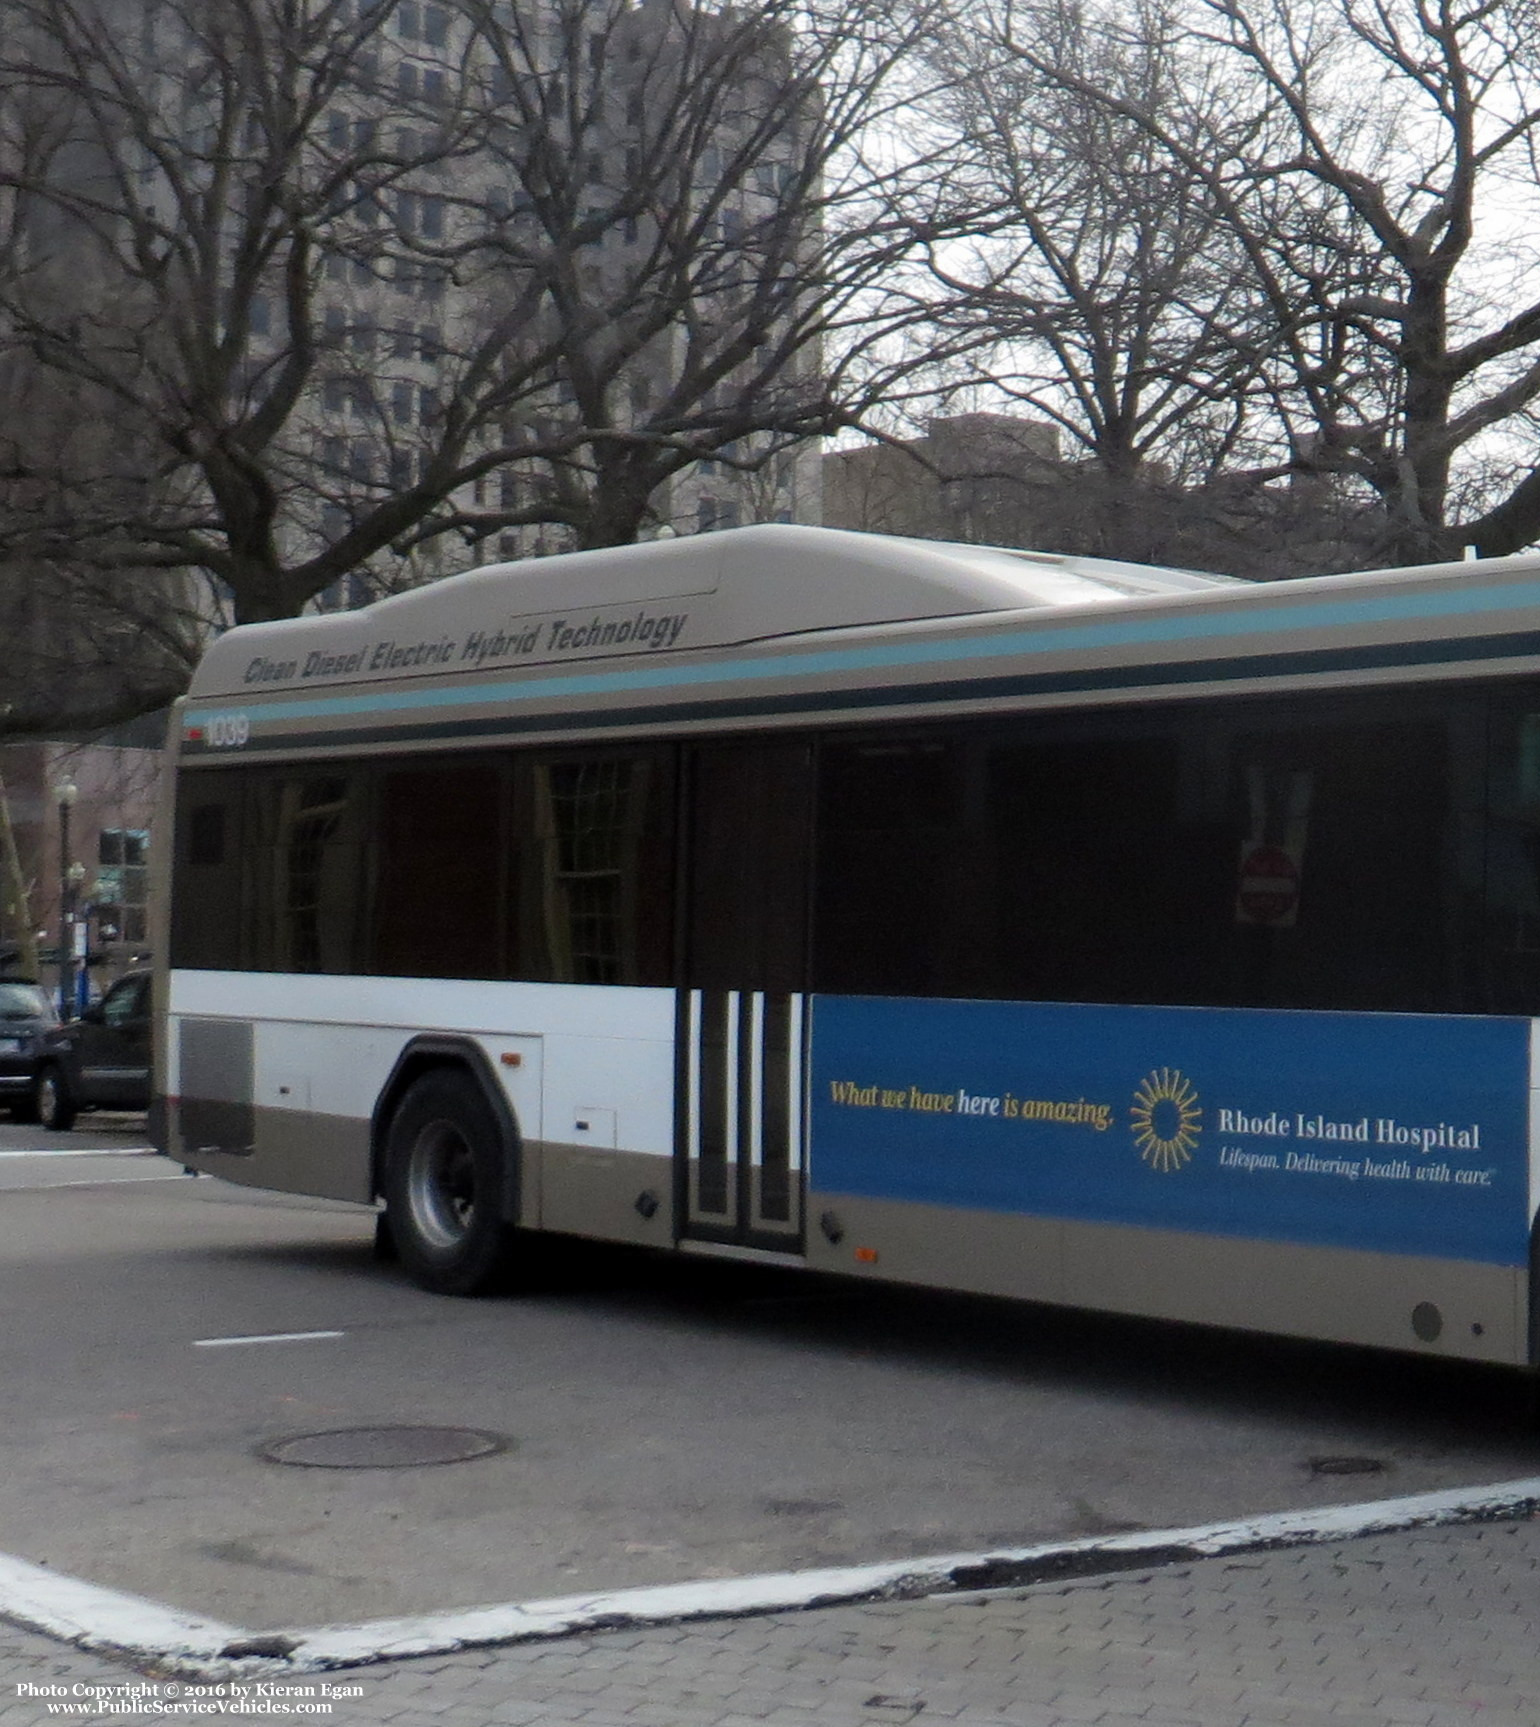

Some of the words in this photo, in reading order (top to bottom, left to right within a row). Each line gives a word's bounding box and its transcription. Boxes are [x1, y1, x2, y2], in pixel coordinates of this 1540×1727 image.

[243, 655, 298, 684] Clean
[301, 644, 370, 678] Diesel
[369, 634, 457, 671] Electric
[460, 622, 543, 667] Hybrid
[547, 611, 689, 649] Technology
[207, 713, 249, 747] 1039
[830, 1079, 878, 1106] What
[881, 1090, 906, 1109] we
[909, 1086, 955, 1113] have
[956, 1088, 1000, 1117] here
[1003, 1091, 1019, 1118] is
[1021, 1096, 1115, 1132] amazing.
[1218, 1108, 1291, 1137] Rhode
[1295, 1113, 1369, 1143] Island
[1375, 1118, 1482, 1154] Hospital
[1218, 1146, 1281, 1173] Lifespan.
[1284, 1150, 1361, 1182] Delivering
[1363, 1157, 1412, 1180] health
[1415, 1162, 1451, 1185] with
